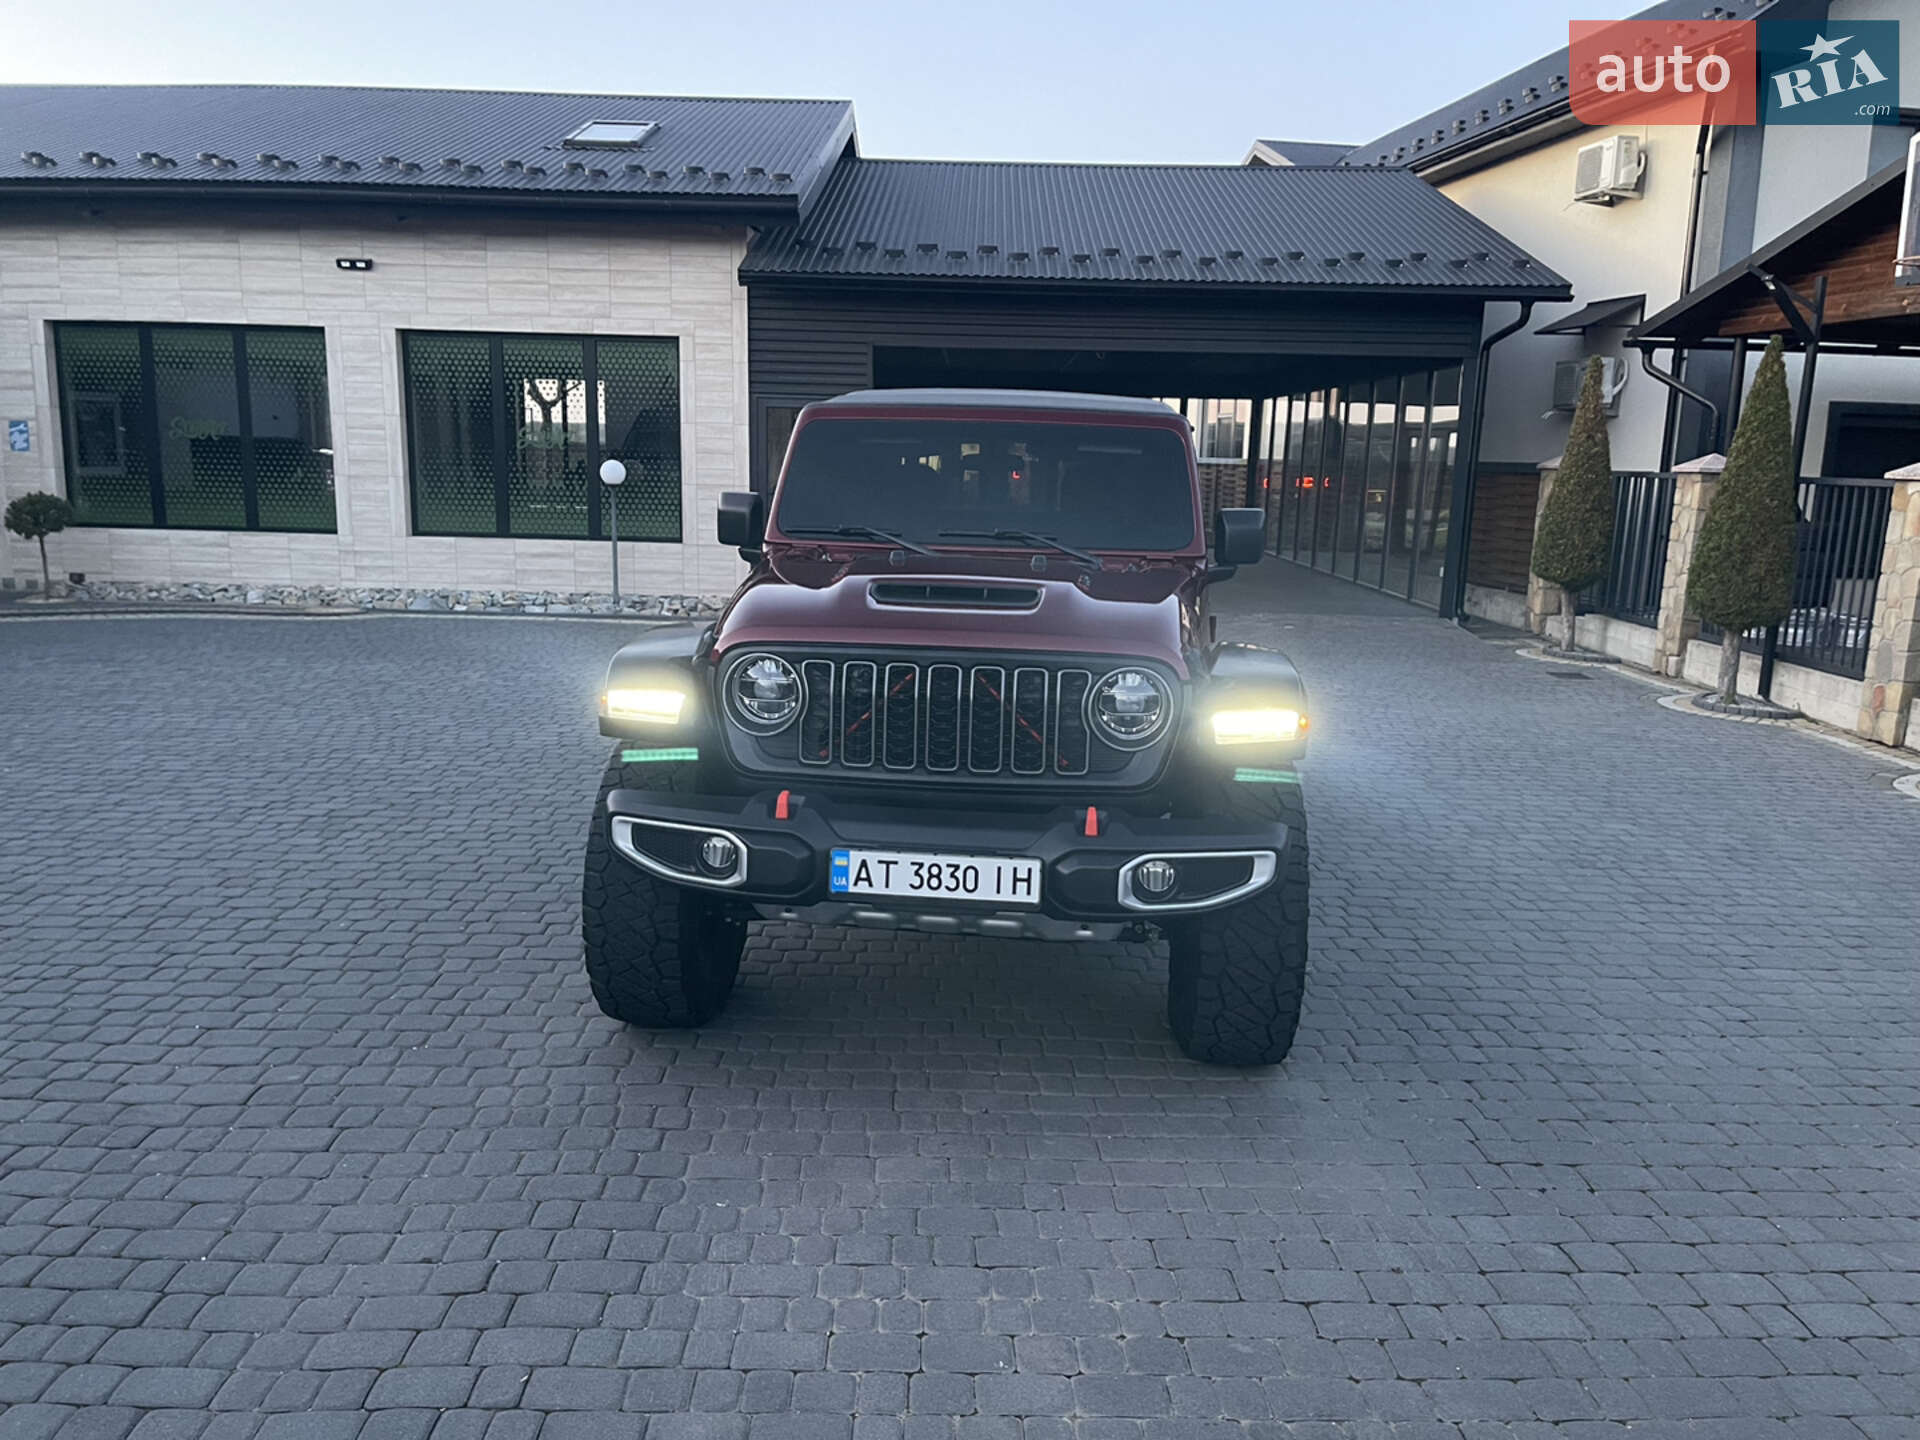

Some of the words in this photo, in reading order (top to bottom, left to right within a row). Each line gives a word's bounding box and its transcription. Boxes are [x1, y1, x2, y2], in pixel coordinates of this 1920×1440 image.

[833, 876, 848, 886] UA
[852, 858, 899, 889] AT
[908, 861, 980, 894] 3830
[996, 866, 1032, 896] IH
